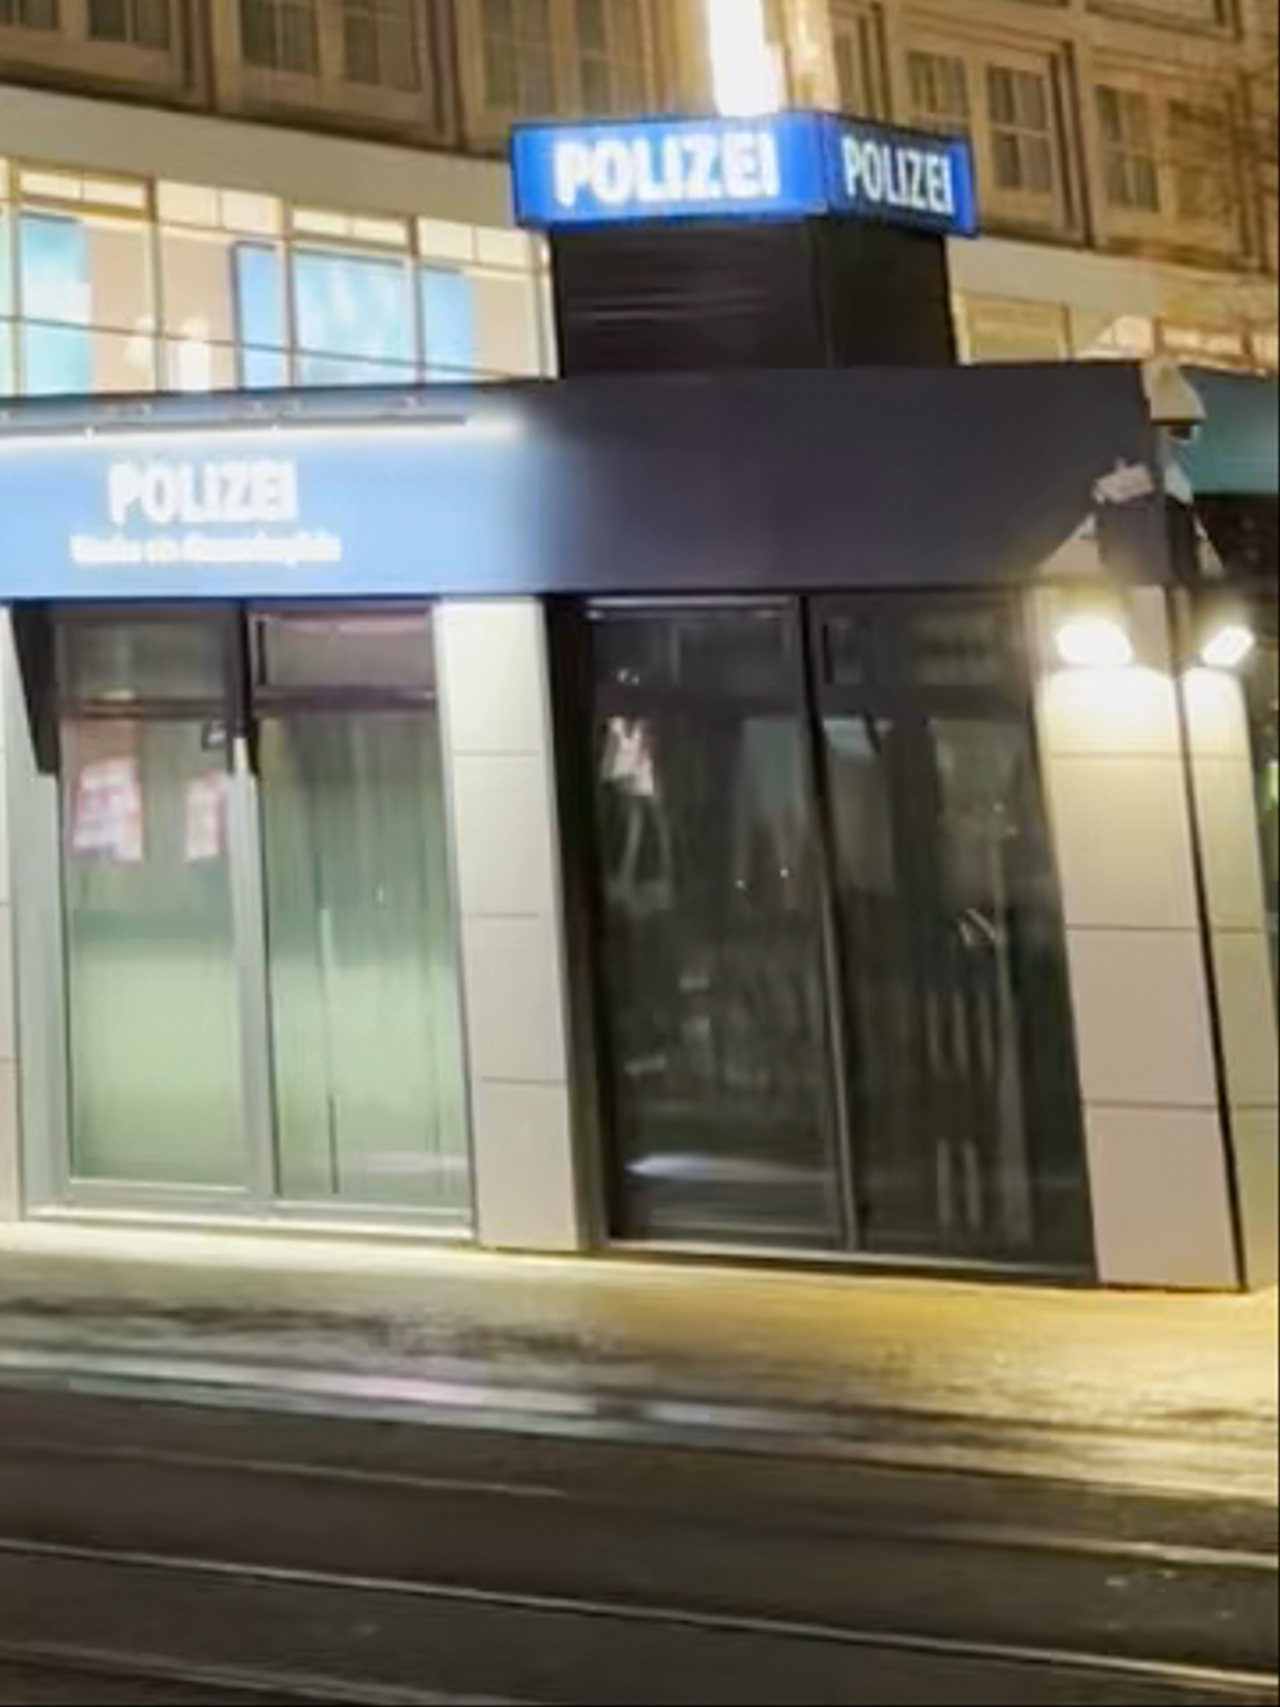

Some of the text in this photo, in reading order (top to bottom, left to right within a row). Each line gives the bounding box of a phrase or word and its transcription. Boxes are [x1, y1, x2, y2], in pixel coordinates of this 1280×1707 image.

[553, 131, 780, 207] POLIZEI
[842, 137, 954, 215] POLIZEI
[108, 460, 299, 523] POLIZEI
